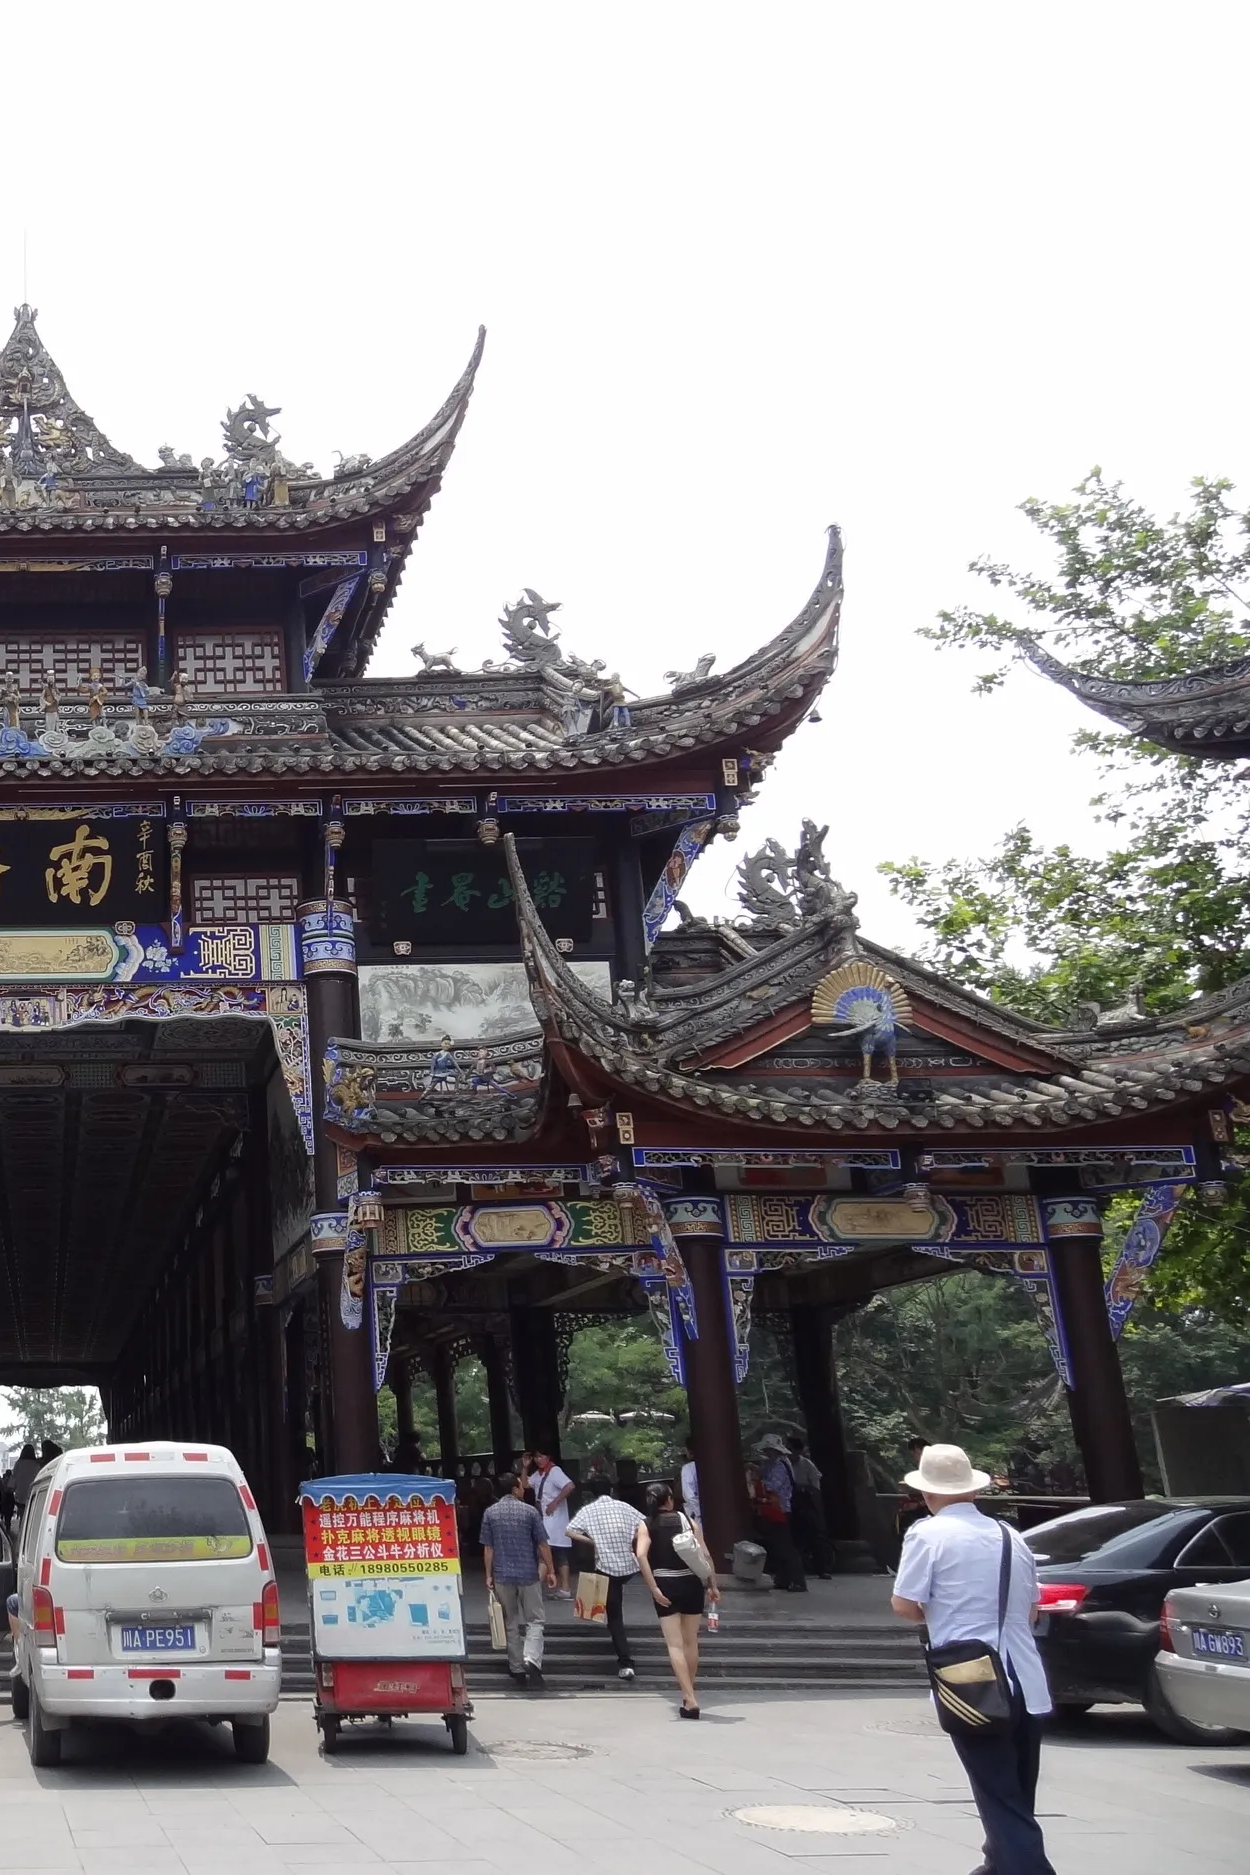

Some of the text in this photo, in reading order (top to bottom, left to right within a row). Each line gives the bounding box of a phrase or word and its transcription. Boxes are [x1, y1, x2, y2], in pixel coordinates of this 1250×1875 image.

[135, 819, 155, 894] 辛酉秋
[319, 1509, 440, 1529] 遥控万能程序麻将机
[321, 1525, 443, 1545] 扑克麻将透视眼镜
[322, 1543, 444, 1562] 金花三公斗牛分析仪
[360, 1561, 449, 1575] 18980550285
